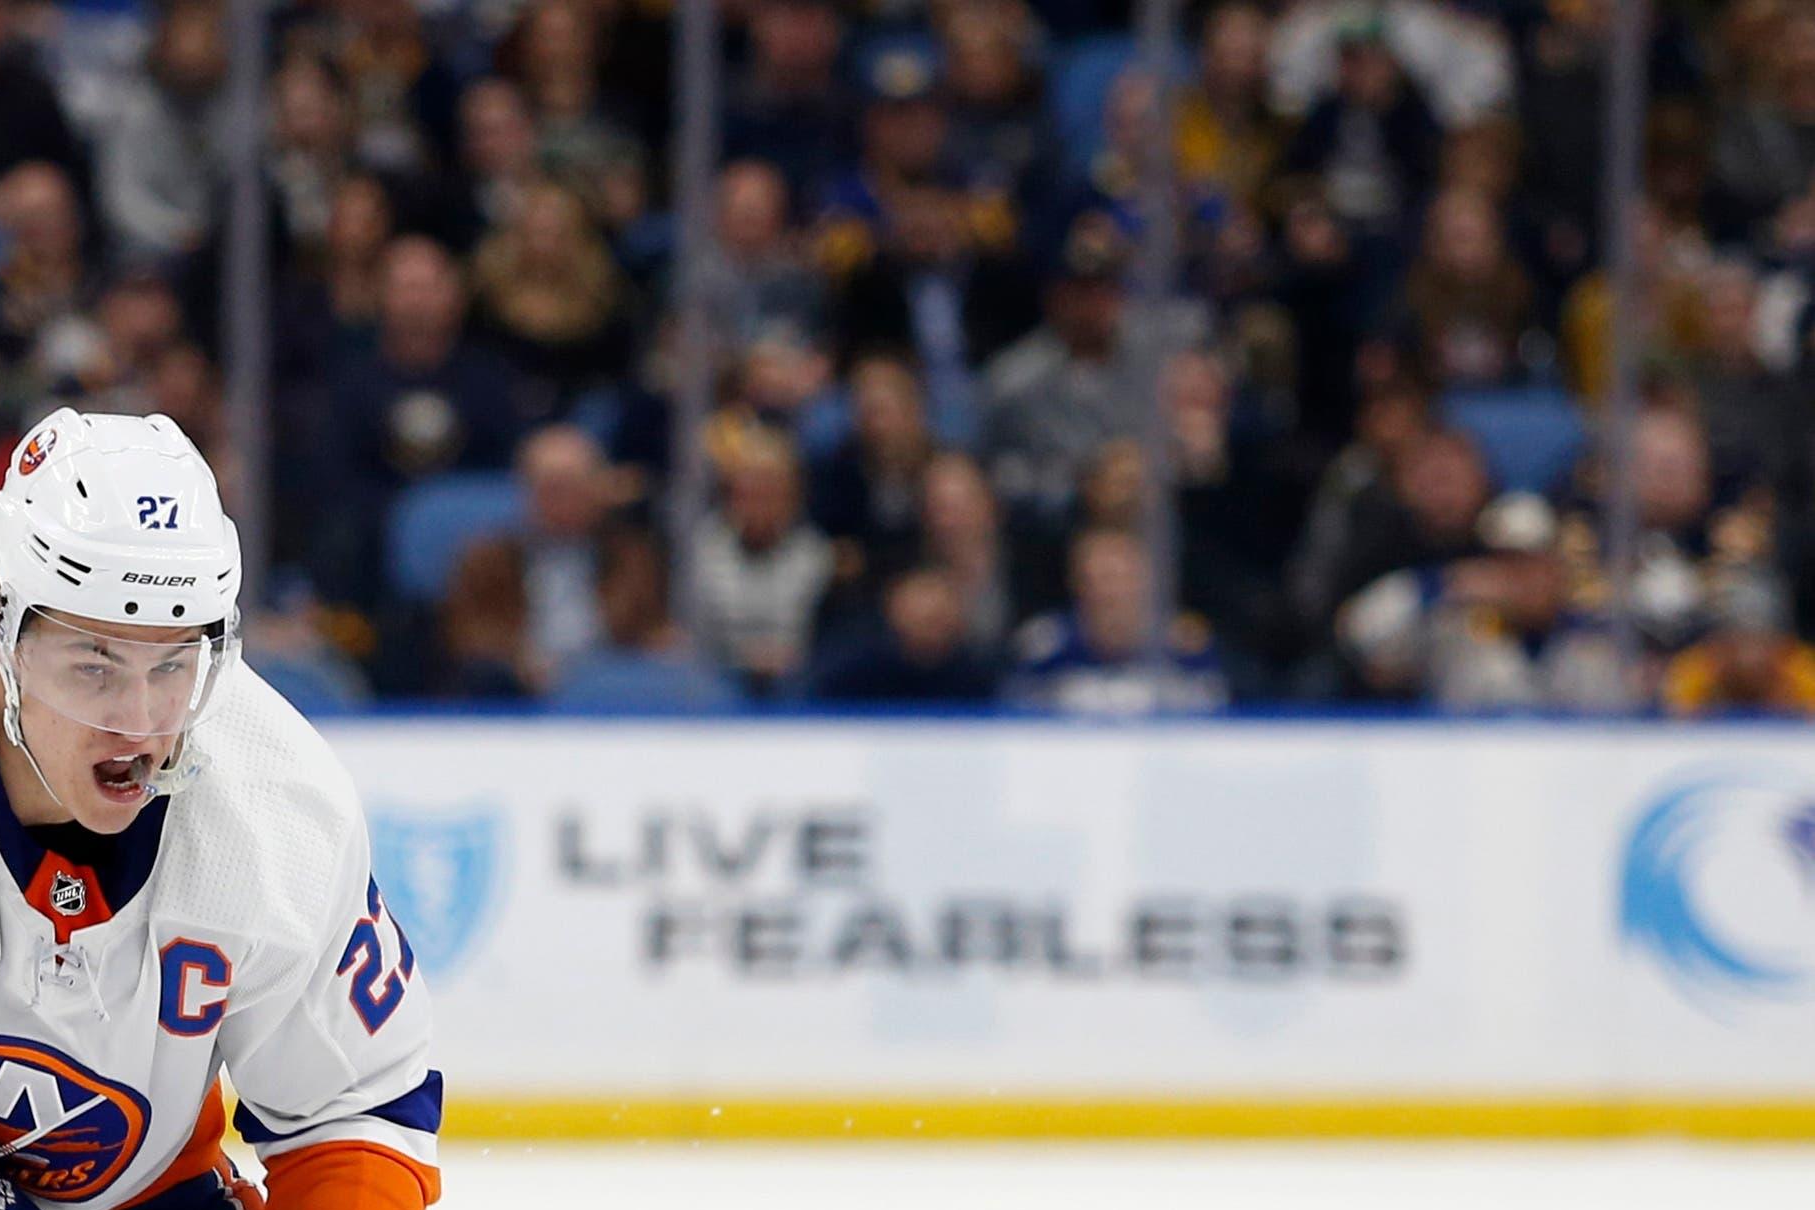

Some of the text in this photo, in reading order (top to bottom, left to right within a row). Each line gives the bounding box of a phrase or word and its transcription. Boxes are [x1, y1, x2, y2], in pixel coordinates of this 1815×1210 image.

[136, 495, 179, 530] 27
[553, 808, 875, 886] LIVE
[645, 896, 1407, 982] FEARLESS
[159, 936, 232, 1037] C
